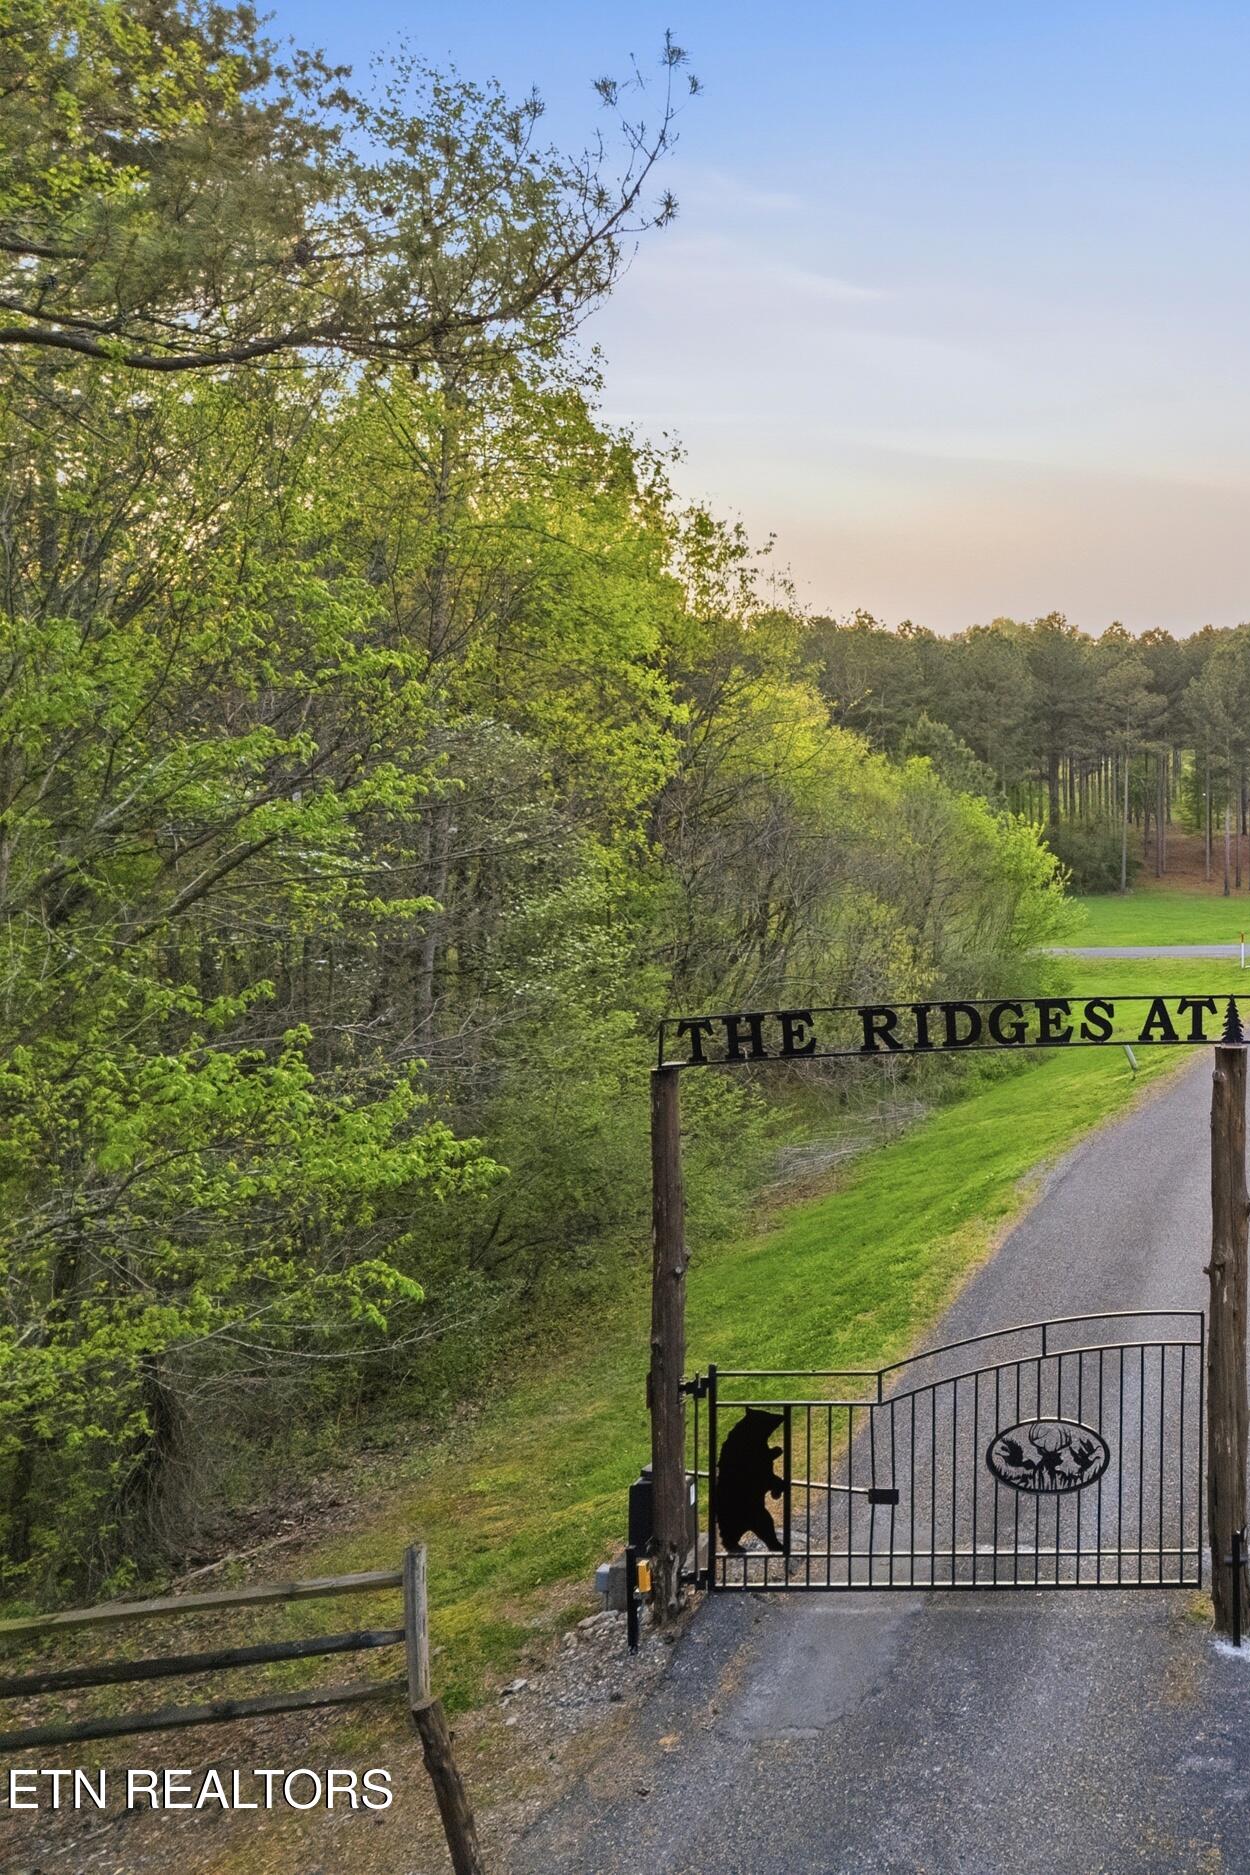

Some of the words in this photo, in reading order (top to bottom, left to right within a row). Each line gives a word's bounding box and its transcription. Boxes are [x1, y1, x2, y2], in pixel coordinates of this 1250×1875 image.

[678, 1011, 816, 1062] THE
[858, 1000, 1114, 1051] RIDGES
[1140, 998, 1217, 1041] AT
